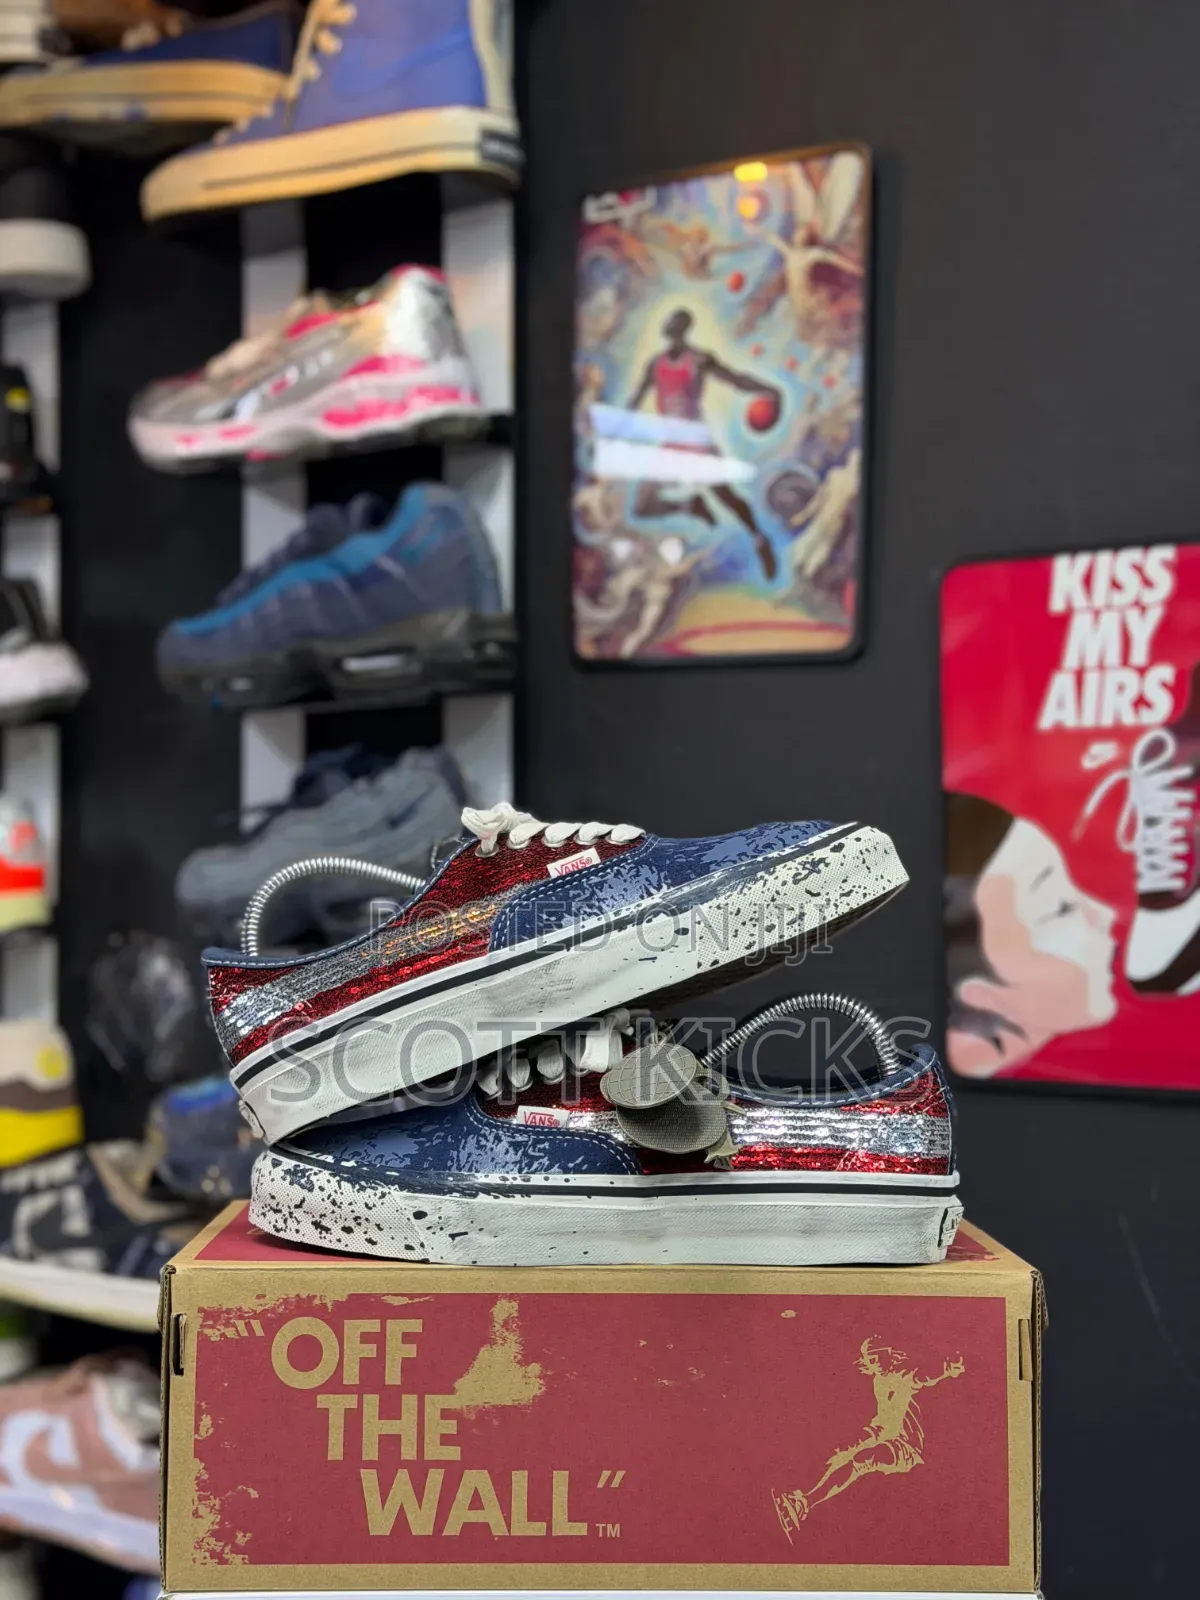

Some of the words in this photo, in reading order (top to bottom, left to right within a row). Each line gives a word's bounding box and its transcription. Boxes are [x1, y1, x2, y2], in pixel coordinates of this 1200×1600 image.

[1049, 544, 1176, 613] KISS
[1062, 605, 1163, 669] MY
[1038, 663, 1175, 730] AIRS
[317, 1394, 461, 1460] THE
